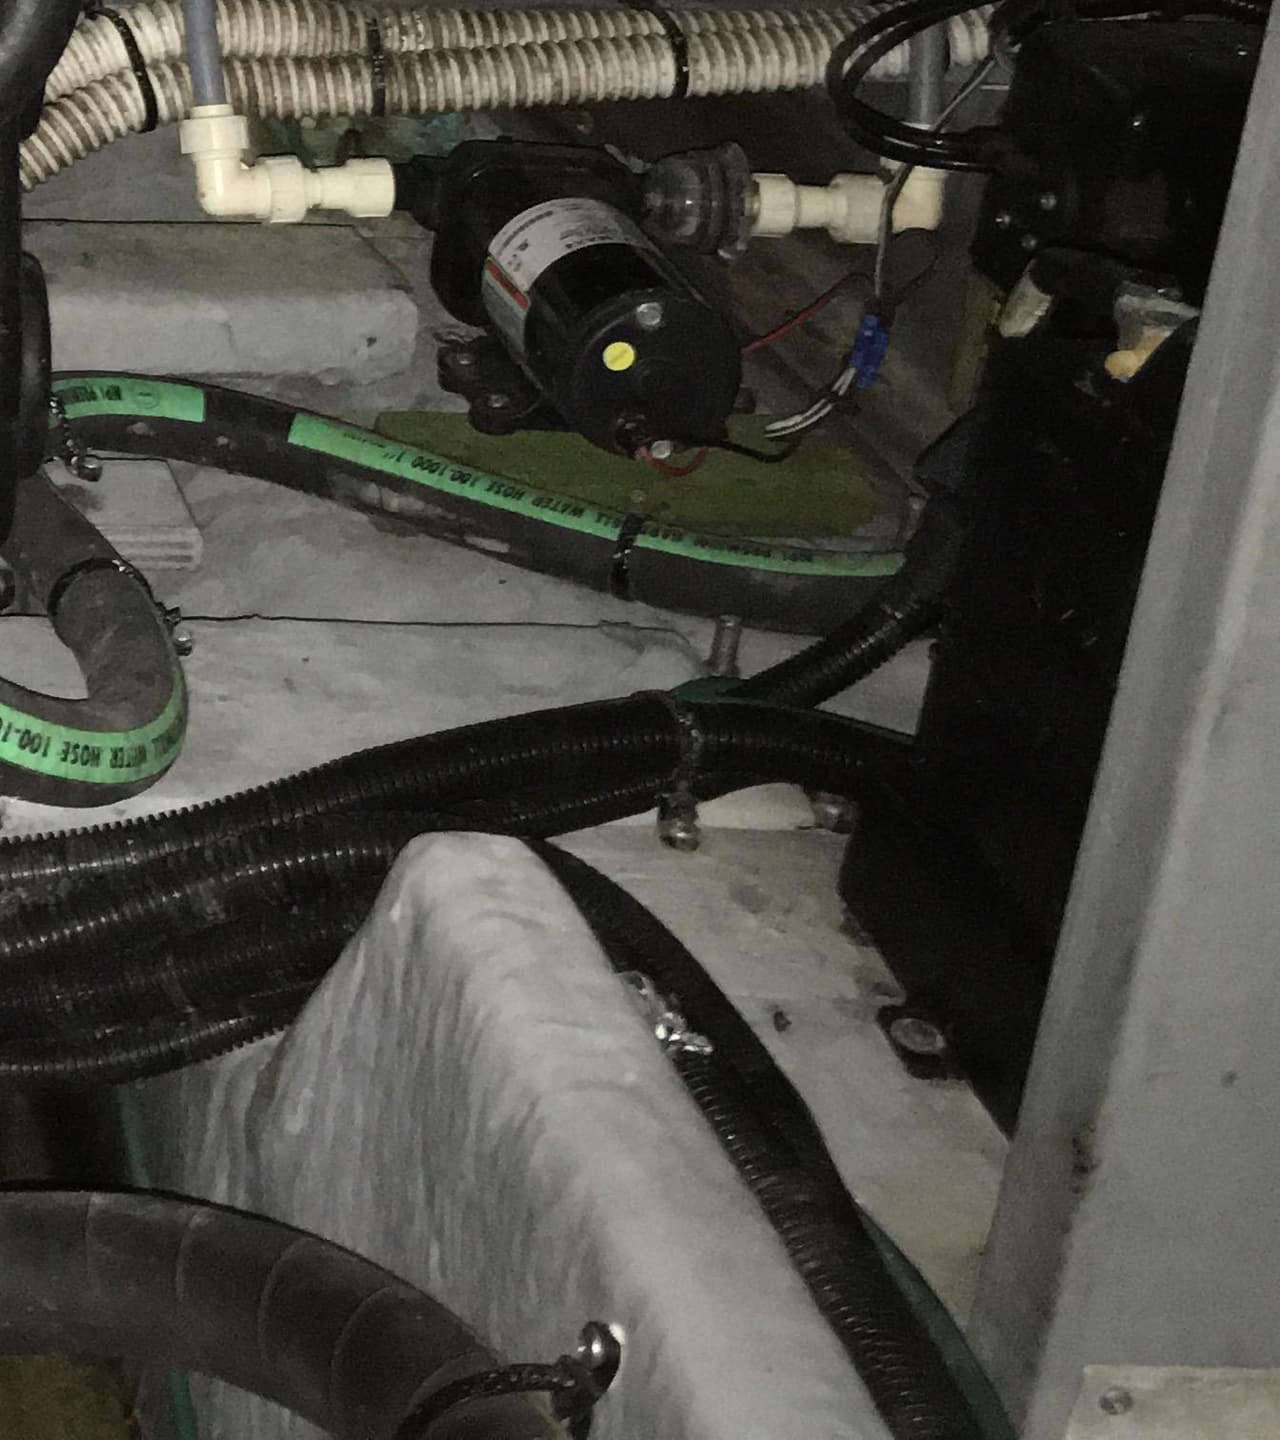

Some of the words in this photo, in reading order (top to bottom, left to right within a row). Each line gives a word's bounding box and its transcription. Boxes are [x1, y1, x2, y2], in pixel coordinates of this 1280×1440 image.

[484, 479, 525, 502] HOSE
[531, 495, 585, 519] WATER
[59, 740, 101, 769] HOSE
